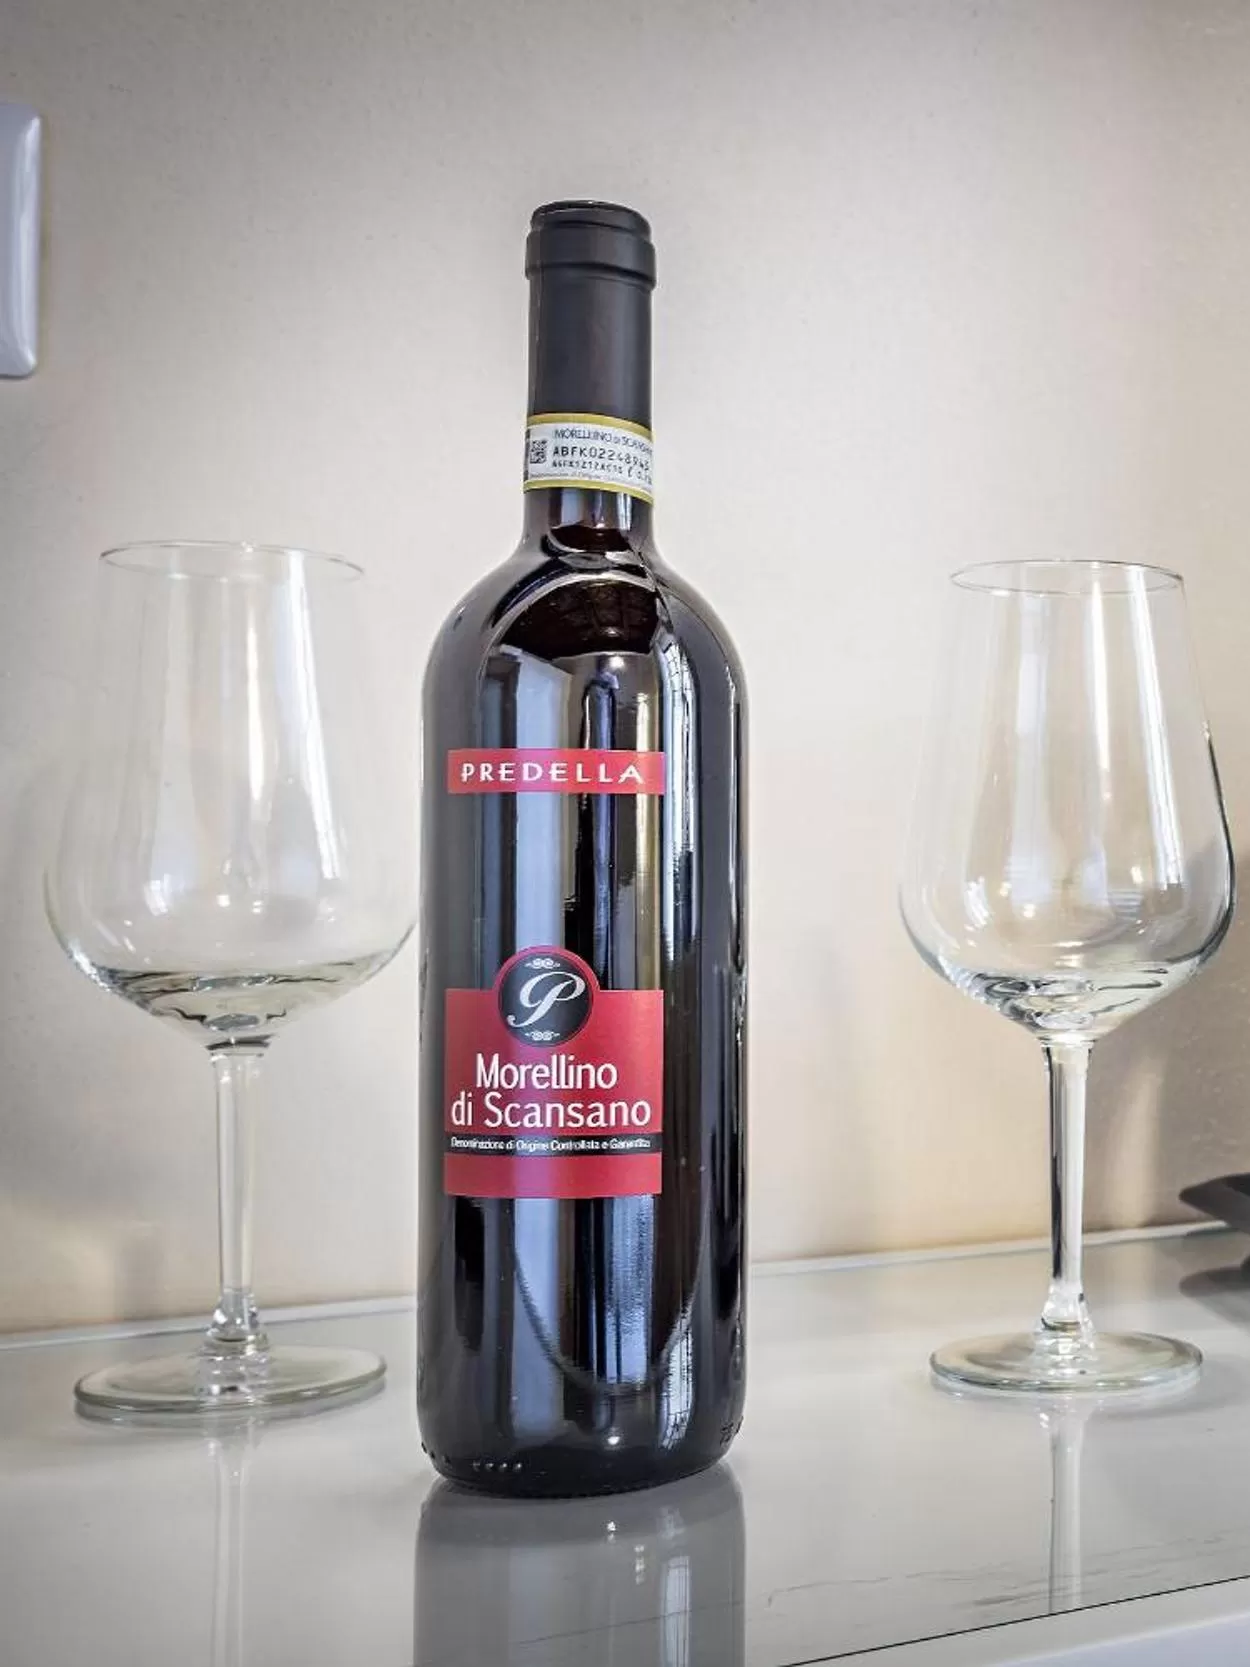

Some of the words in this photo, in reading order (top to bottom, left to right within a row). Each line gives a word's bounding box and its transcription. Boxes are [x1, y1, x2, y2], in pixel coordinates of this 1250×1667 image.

[461, 762, 645, 785] PREDELLA
[507, 971, 586, 1029] P
[476, 1053, 618, 1090] Morellino
[451, 1090, 473, 1127] di
[484, 1091, 651, 1128] Scansano
